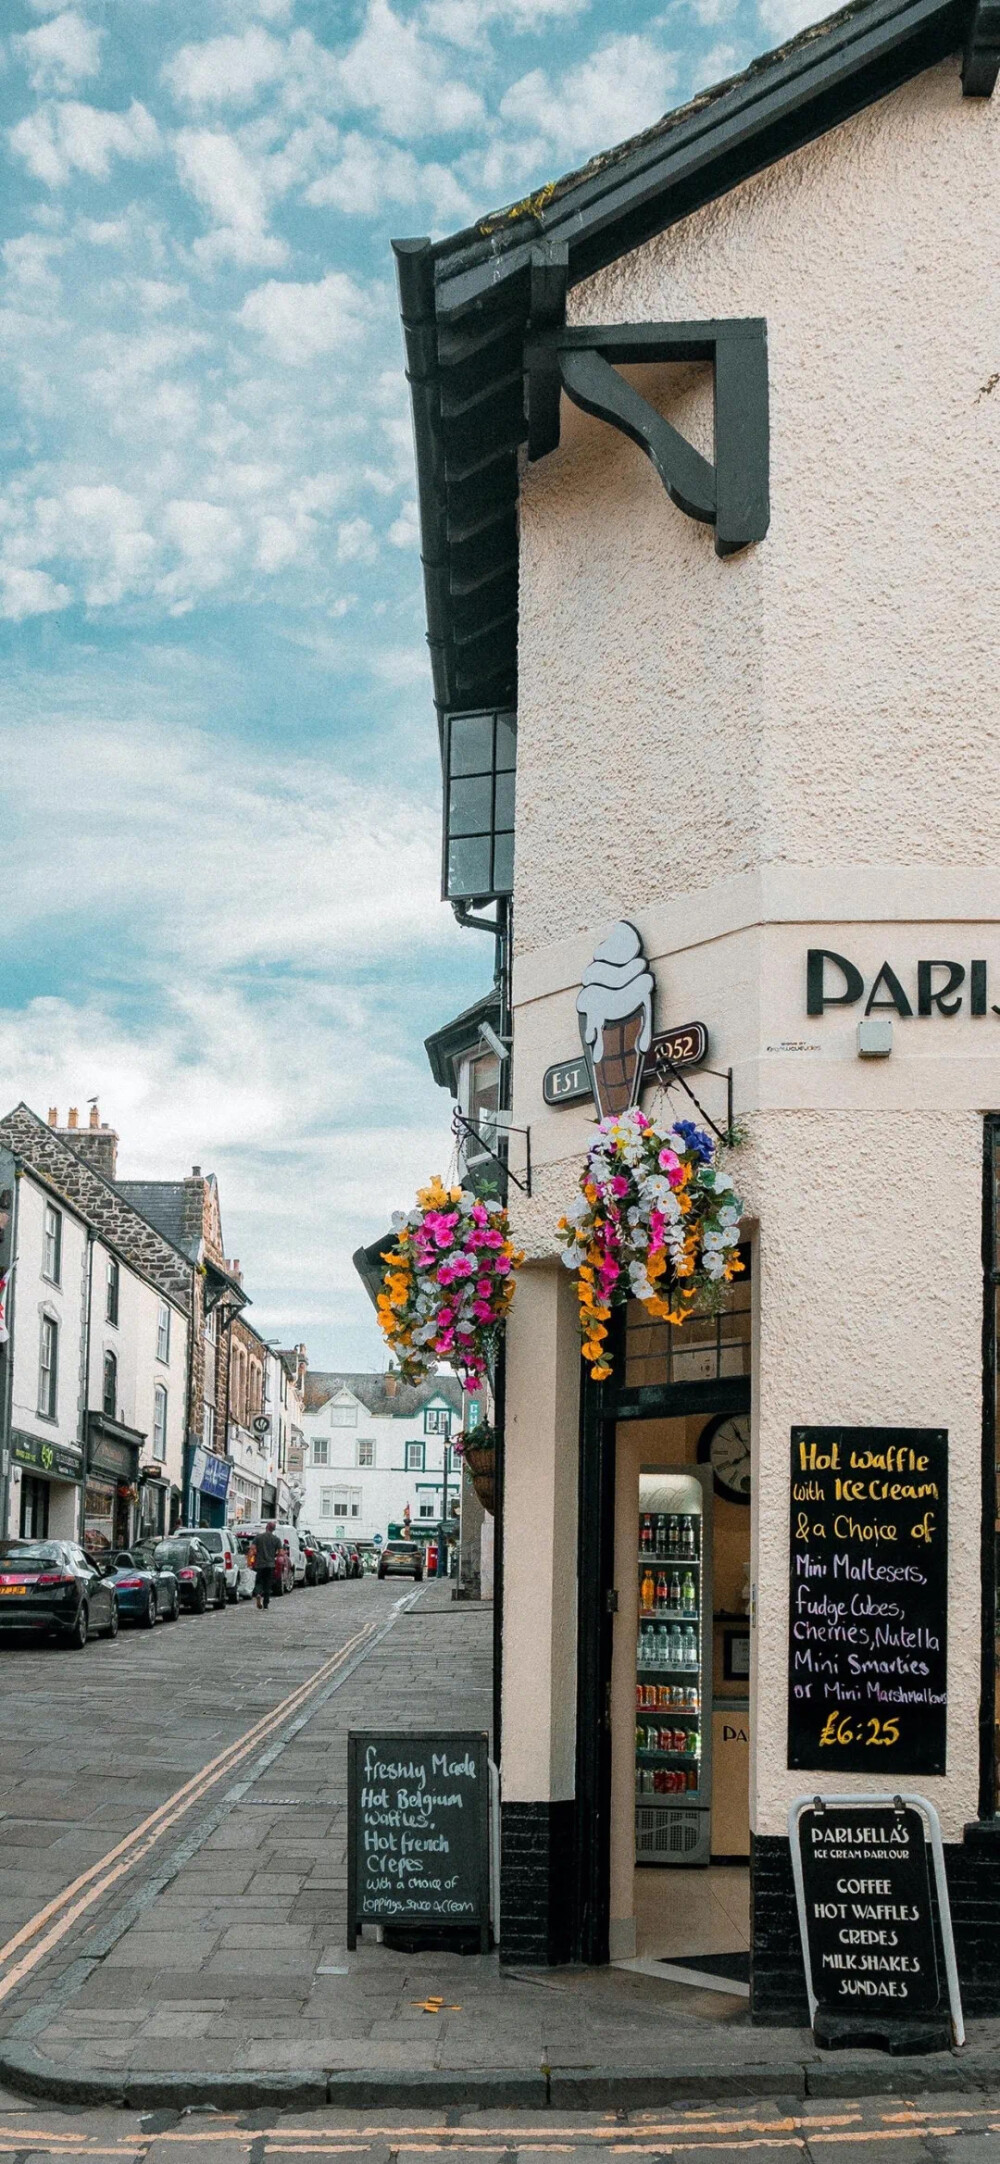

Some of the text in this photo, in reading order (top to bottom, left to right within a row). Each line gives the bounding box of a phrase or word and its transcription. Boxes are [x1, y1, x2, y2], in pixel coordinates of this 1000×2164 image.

[806, 948, 1000, 1017] PARI
[656, 1036, 694, 1060] 952
[552, 1069, 581, 1095] EST
[799, 1442, 842, 1471] Hot
[793, 1481, 825, 1501] with
[910, 1512, 937, 1543] of
[796, 1554, 928, 1585] Mini Maltesers,
[851, 1593, 905, 1620] Cubes,
[875, 1623, 940, 1651] Nutella
[795, 1649, 930, 1676] Mini Smarties
[794, 1683, 813, 1698] or
[824, 1681, 861, 1701] Mini
[723, 1725, 749, 1742] PA
[361, 1788, 463, 1816] Hot Belgium
[364, 1830, 397, 1851] Hot
[811, 1824, 910, 1844] PARISELLA'S
[814, 1849, 909, 1859] ICE CREAM PARLOUR
[367, 1854, 424, 1878] Crepes
[397, 1880, 404, 1889] a
[444, 1875, 460, 1889] of
[836, 1879, 892, 1895] COFFEE
[814, 1903, 920, 1921] HOT WAFFLES
[839, 1929, 899, 1946] CREPES
[838, 1980, 908, 1998] SUNDAES
